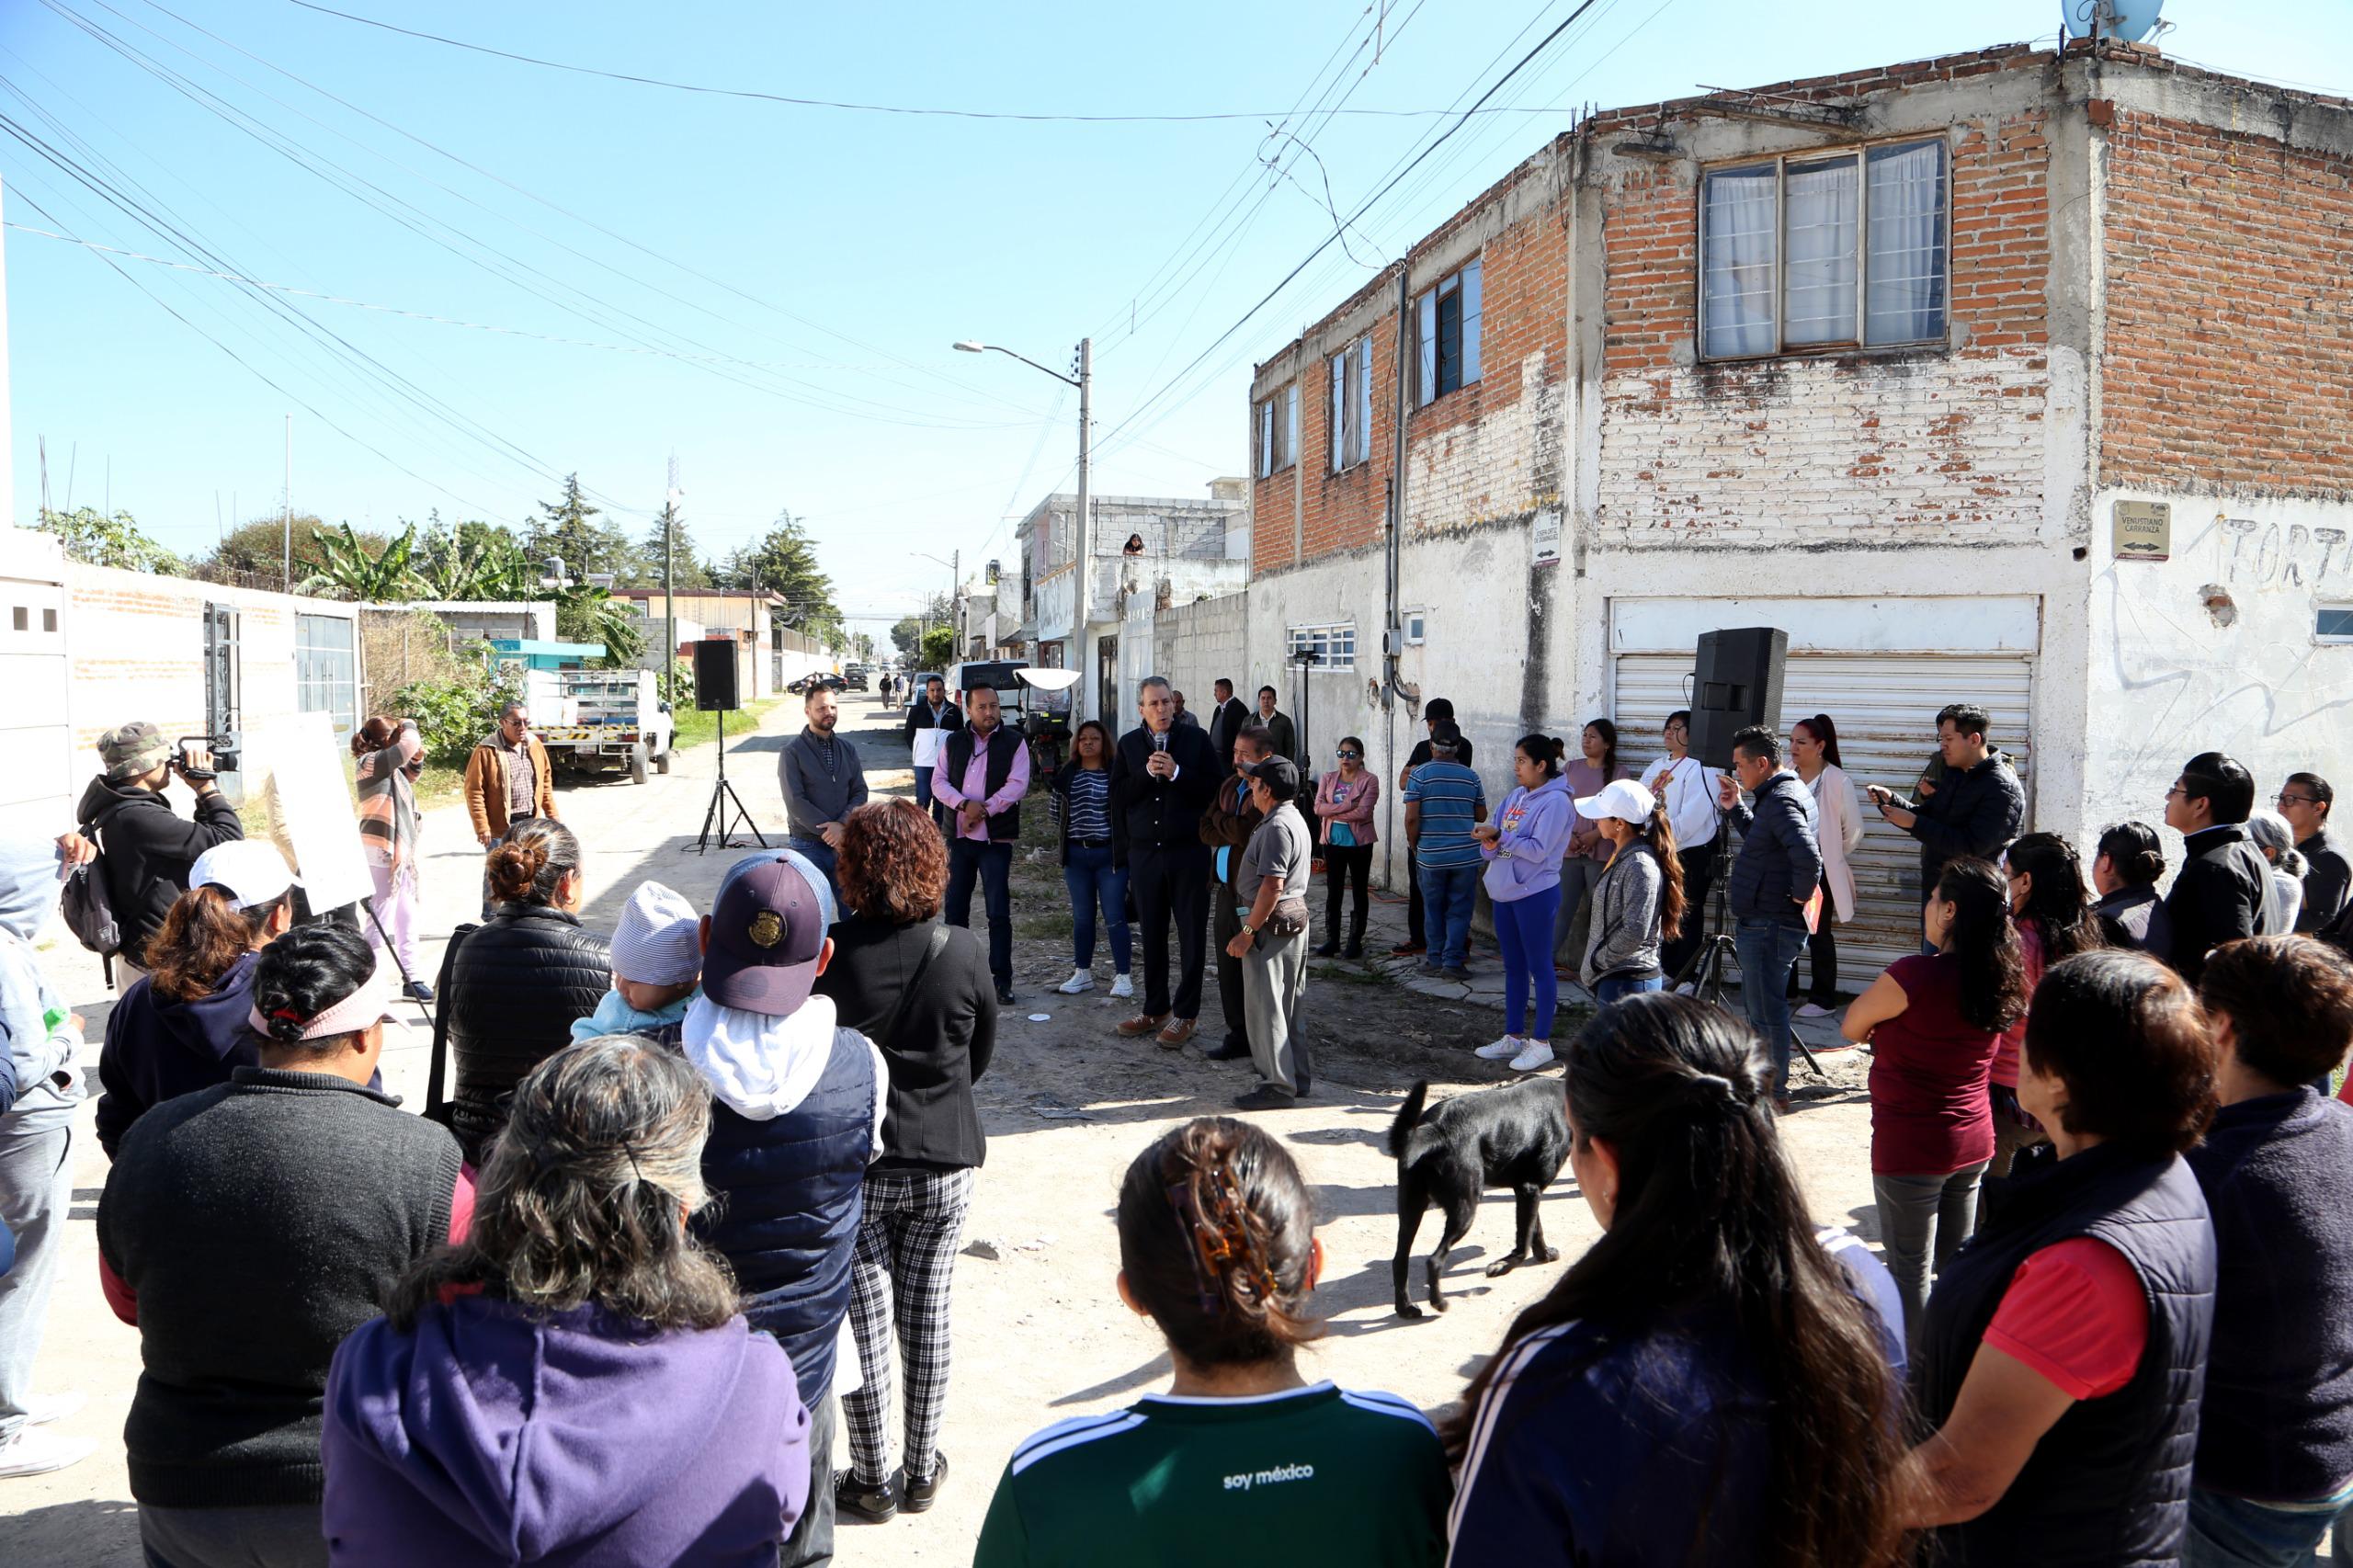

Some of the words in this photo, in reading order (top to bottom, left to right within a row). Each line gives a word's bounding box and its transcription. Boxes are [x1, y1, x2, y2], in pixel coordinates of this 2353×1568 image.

[2121, 517, 2164, 527] VENUSTIANO
[2124, 525, 2161, 534] CARRANZA
[1222, 1472, 1253, 1491] soy
[1256, 1463, 1314, 1484] méxico
